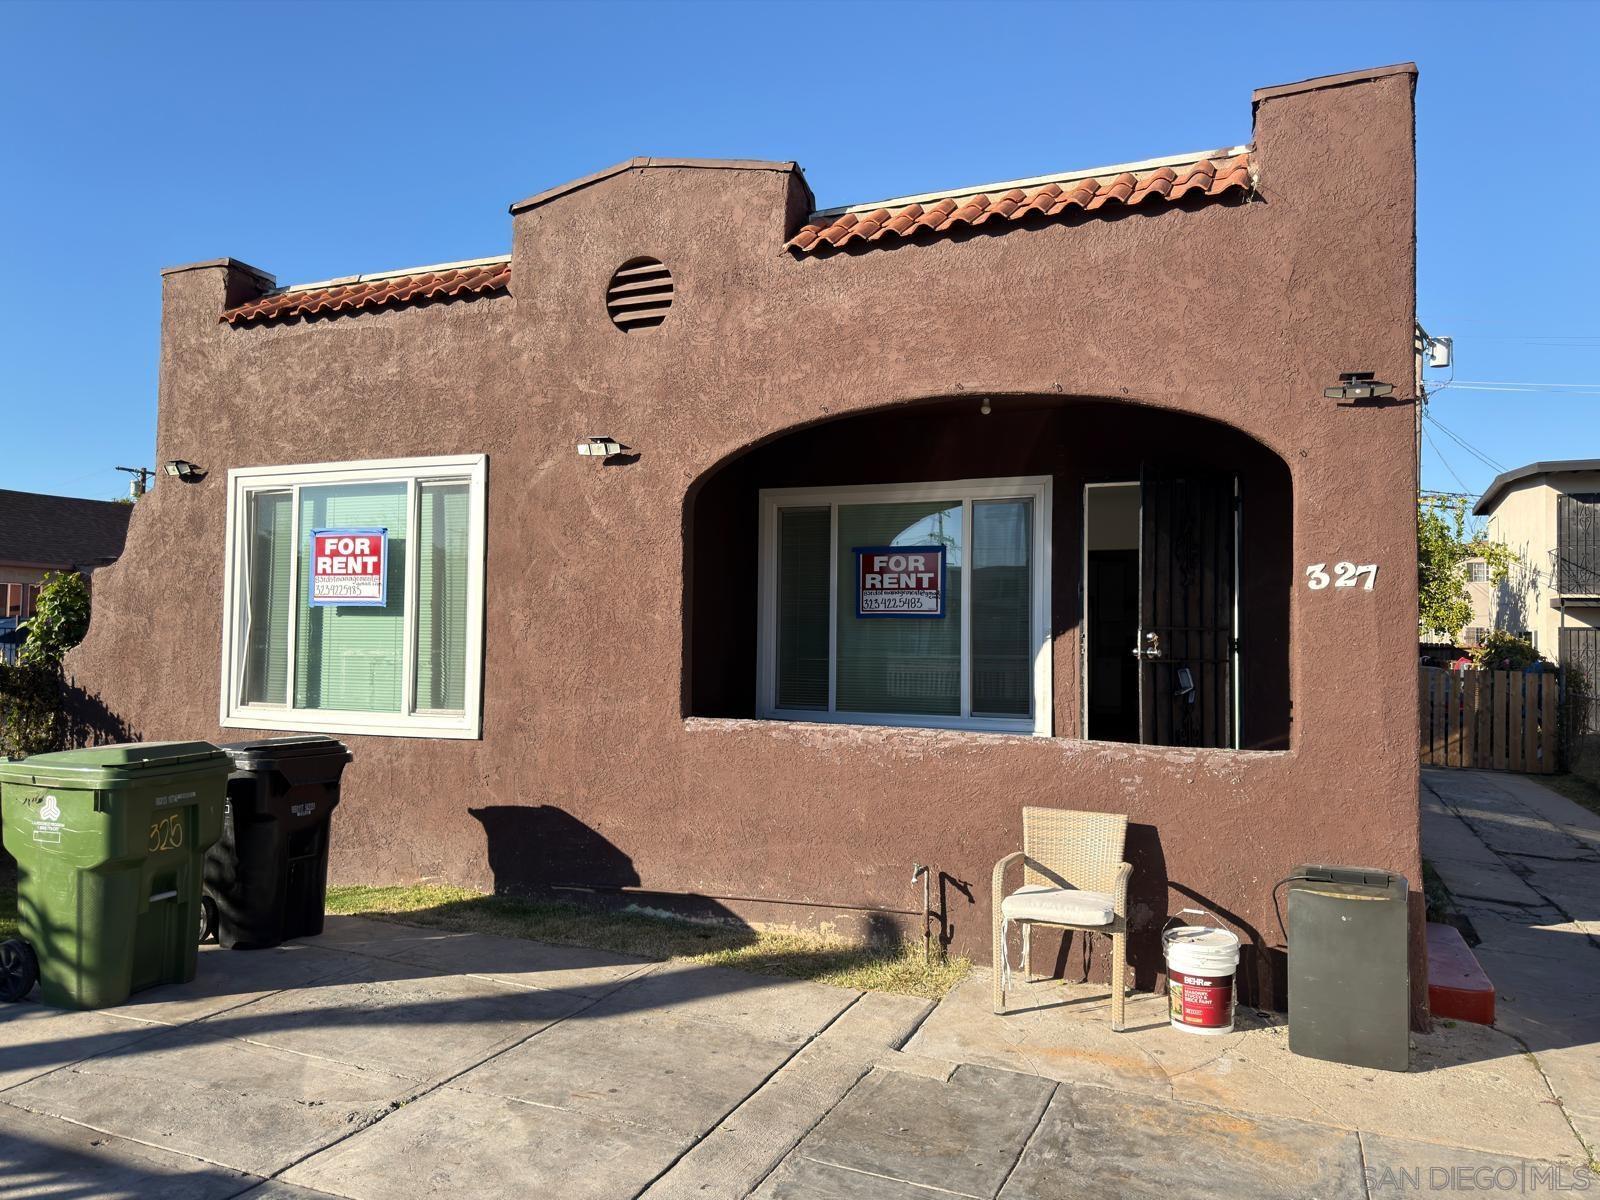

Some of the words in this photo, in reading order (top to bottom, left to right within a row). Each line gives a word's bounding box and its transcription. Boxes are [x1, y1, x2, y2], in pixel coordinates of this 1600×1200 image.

[324, 538, 371, 555] FOR
[316, 556, 378, 574] RENT
[873, 555, 926, 572] FOR
[865, 573, 935, 588] RENT
[1305, 561, 1378, 592] 327
[149, 814, 183, 852] 325
[1183, 976, 1204, 986] BEHR
